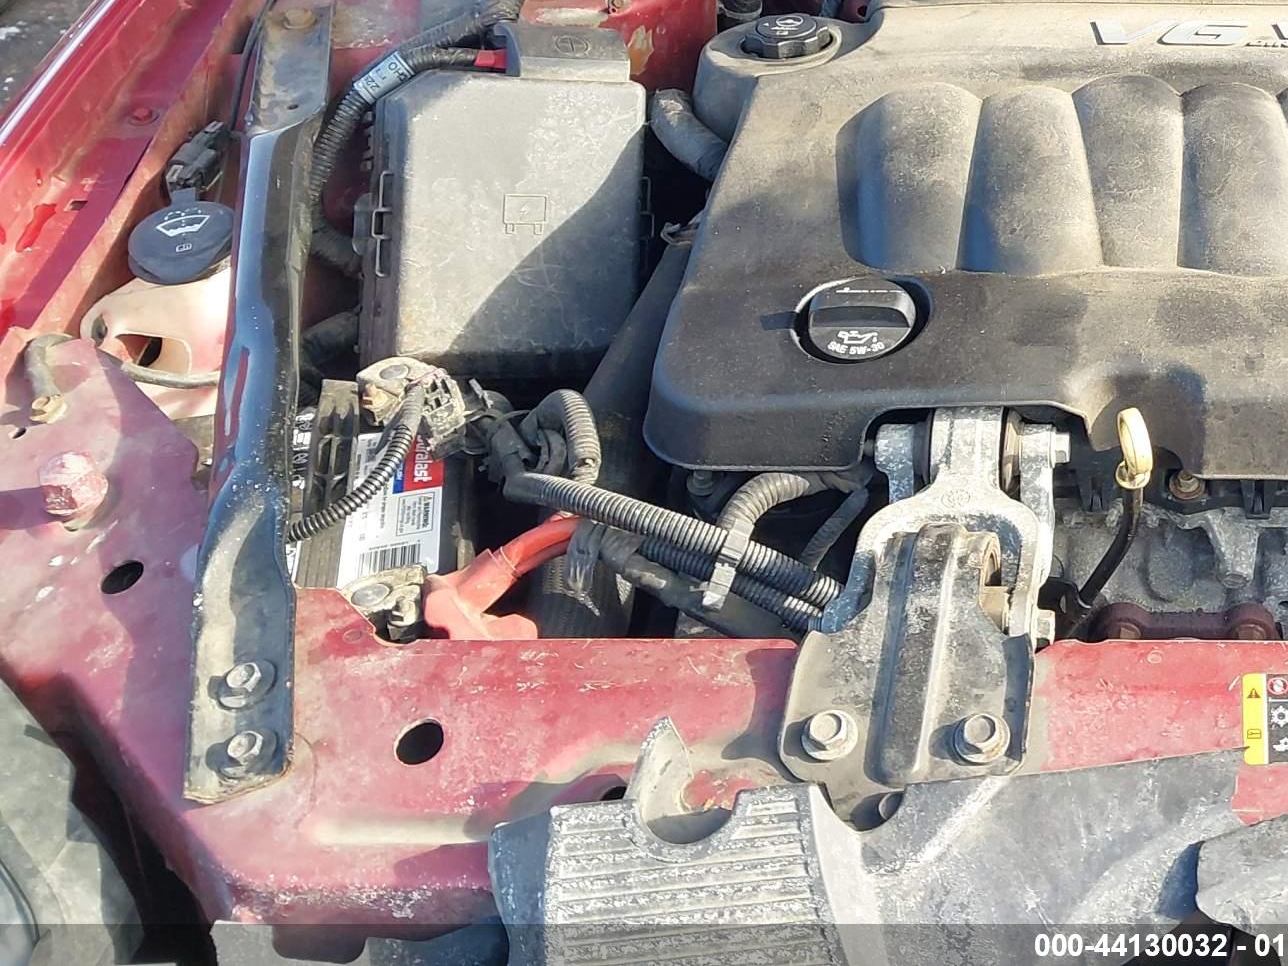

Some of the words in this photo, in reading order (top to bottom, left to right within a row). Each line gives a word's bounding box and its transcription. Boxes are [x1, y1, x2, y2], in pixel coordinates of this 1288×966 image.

[1089, 19, 1248, 47] V6
[827, 341, 848, 354] SAE
[849, 341, 885, 355] 5W-30
[413, 434, 434, 483] uralast
